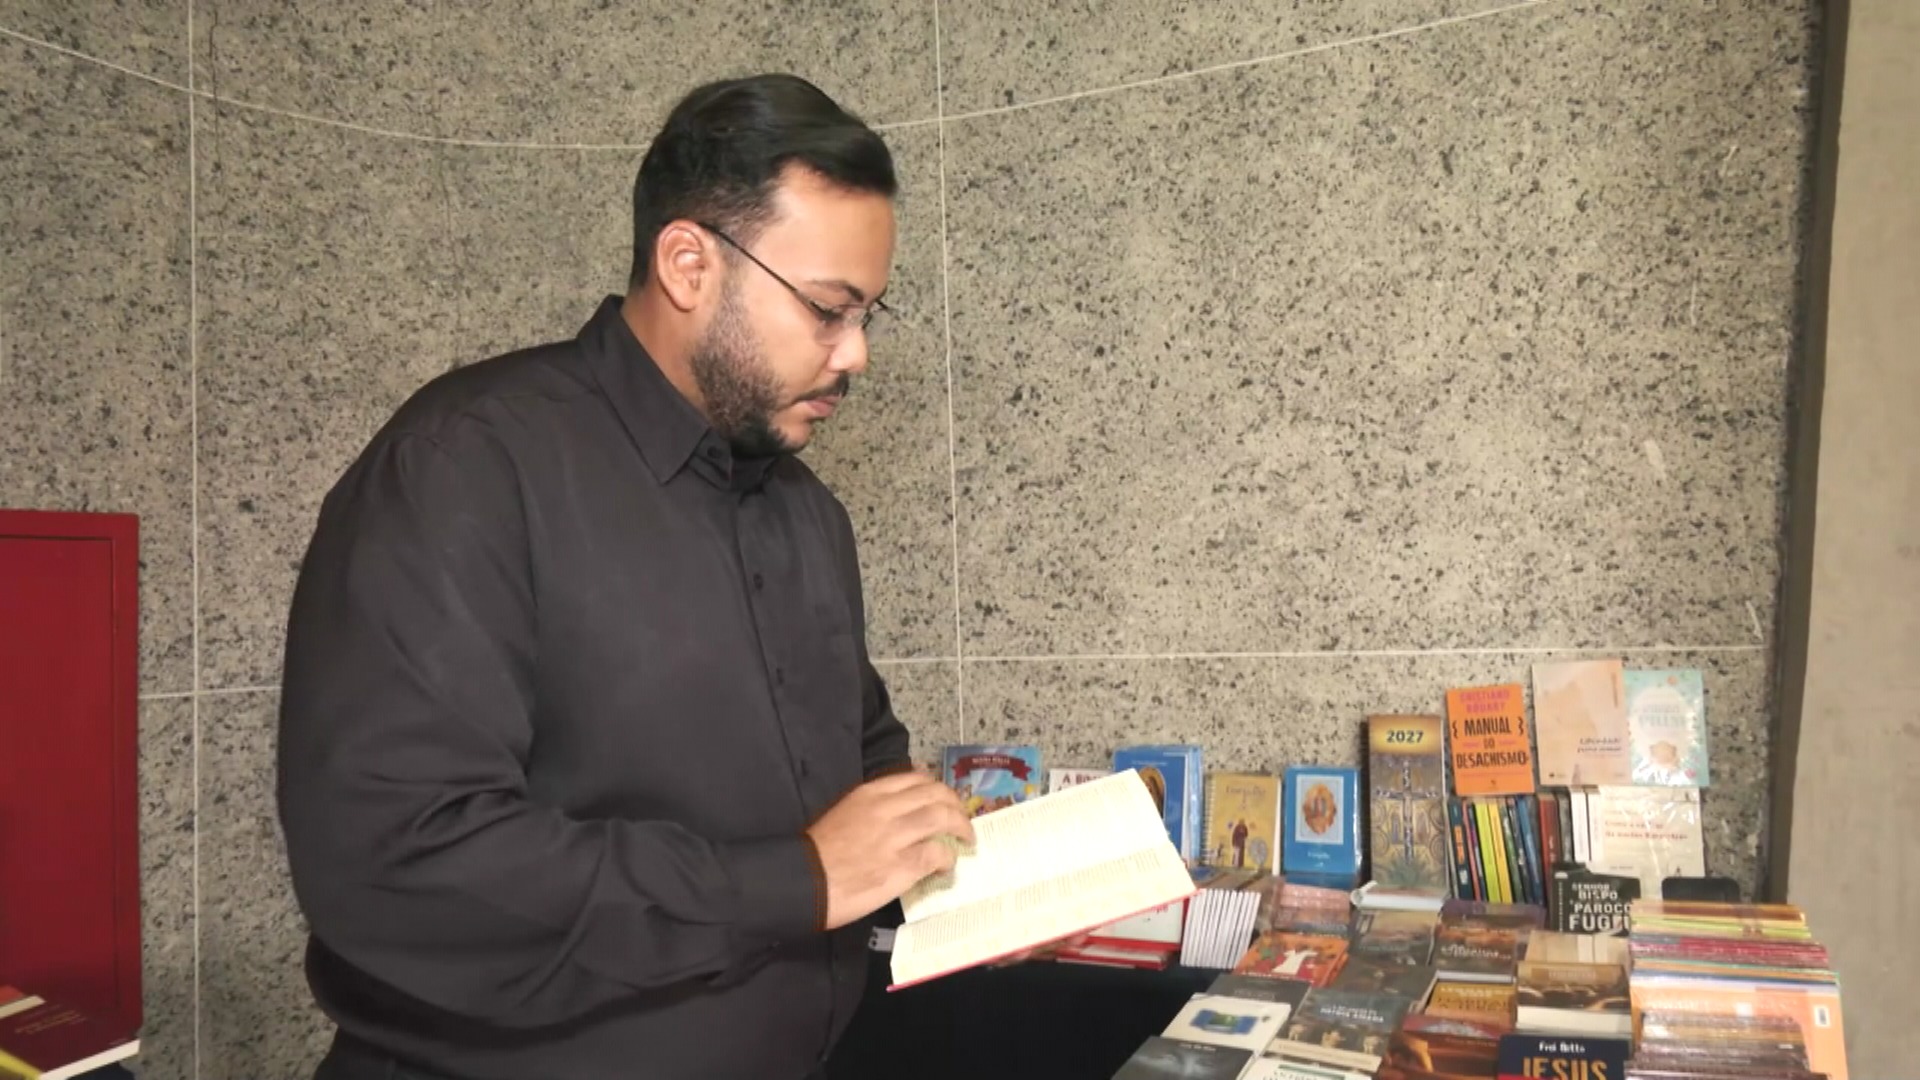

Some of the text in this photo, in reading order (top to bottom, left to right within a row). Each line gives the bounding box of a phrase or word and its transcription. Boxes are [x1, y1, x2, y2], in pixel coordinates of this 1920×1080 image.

[1463, 717, 1512, 736] MANUAL
[1386, 729, 1424, 744] 2027
[1578, 889, 1618, 900] BISPO
[1523, 1057, 1607, 1080] JESUS
